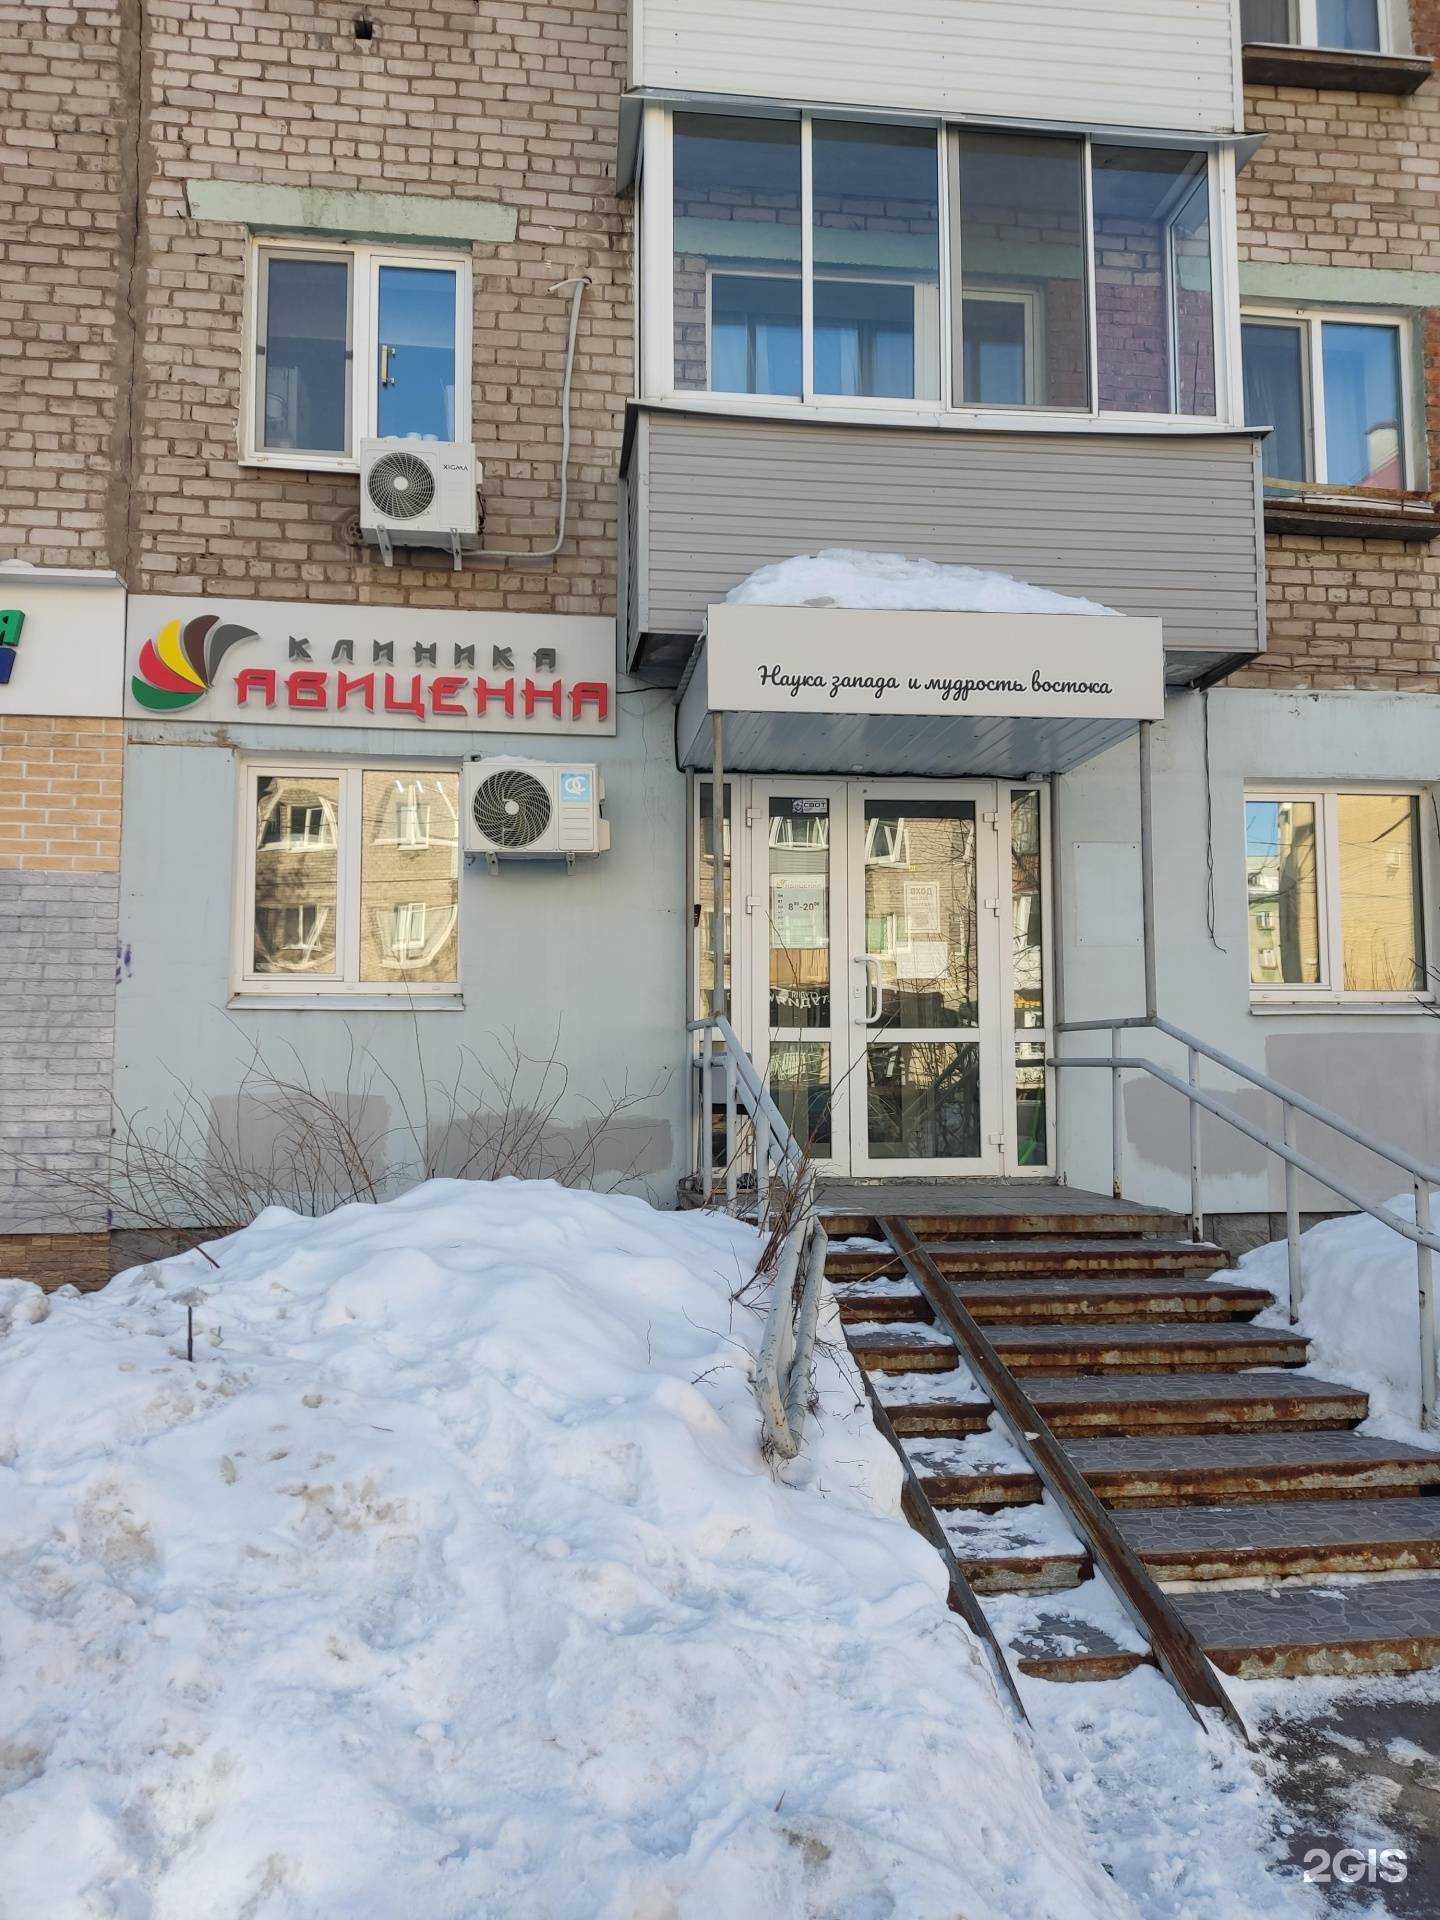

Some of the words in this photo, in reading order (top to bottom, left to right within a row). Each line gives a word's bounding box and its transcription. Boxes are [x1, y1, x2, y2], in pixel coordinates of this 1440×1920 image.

[288, 634, 557, 673] КЛИНИКА
[233, 668, 608, 722] АВИЦЕННА
[757, 664, 827, 697] Наука
[831, 674, 900, 699] запада
[907, 676, 922, 691] и
[924, 675, 1027, 701] мудрость
[1031, 670, 1113, 695] востока
